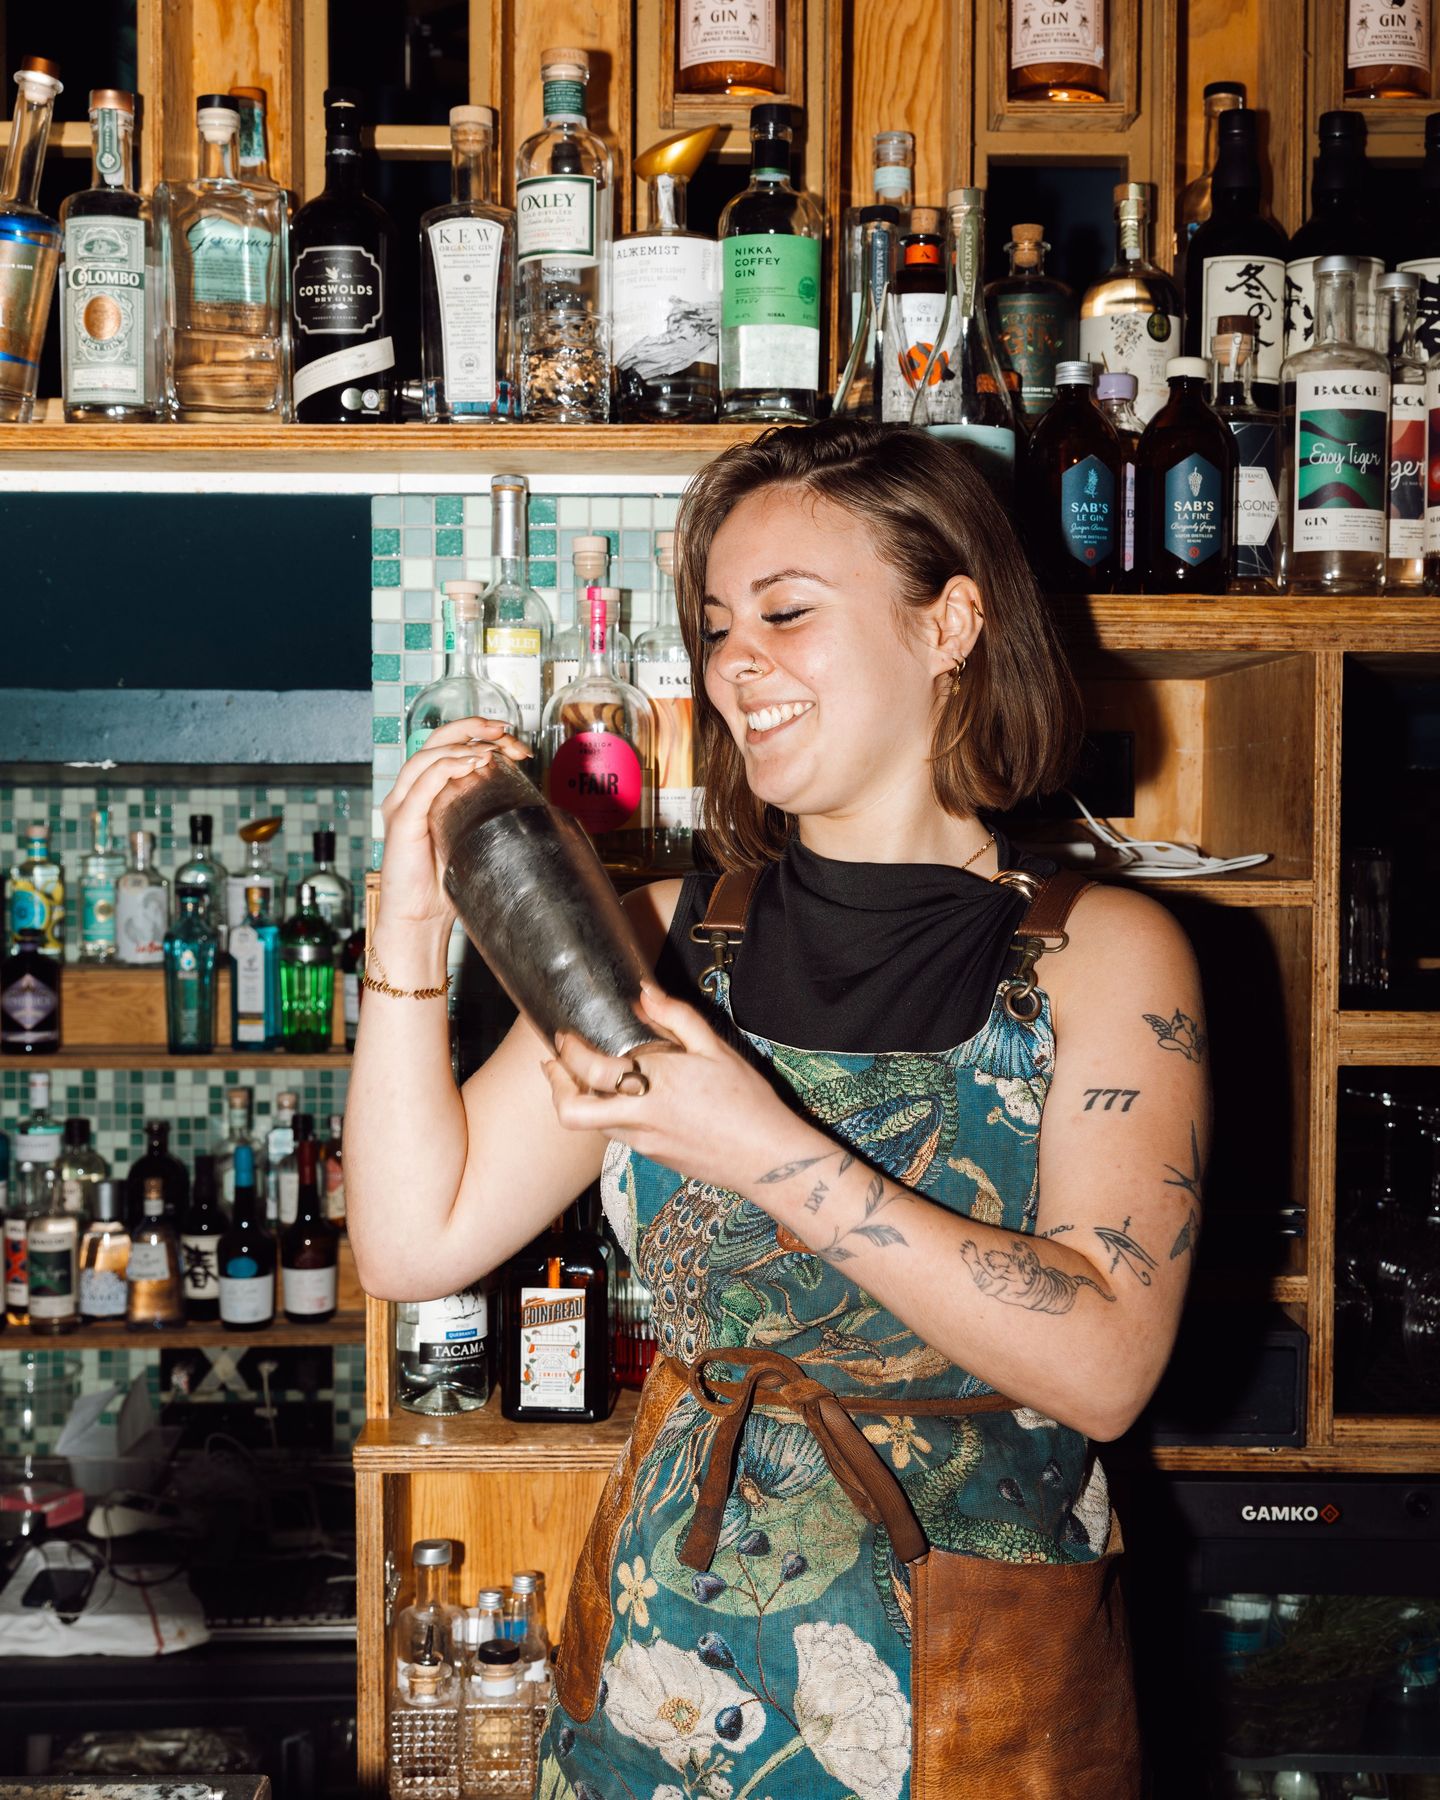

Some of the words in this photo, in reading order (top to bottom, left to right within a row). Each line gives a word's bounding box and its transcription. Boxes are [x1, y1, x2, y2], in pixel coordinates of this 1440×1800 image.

[710, 9, 738, 23] GIN
[1041, 12, 1069, 25] GIN
[1380, 14, 1407, 27] GIN
[521, 193, 576, 212] OXLEY
[440, 228, 493, 244] KEW
[735, 246, 773, 256] NIKKA
[735, 257, 781, 267] COFFEY
[68, 265, 140, 290] COLOMBO
[735, 268, 755, 278] GIN
[299, 284, 373, 297] COTSWOLDS
[1314, 384, 1382, 397] BACCAE
[1392, 396, 1425, 407] CCA
[1309, 442, 1346, 474] Easy
[1347, 442, 1381, 474] Tiger
[1391, 459, 1426, 491] ger
[1071, 501, 1109, 514] SAB'S
[1173, 500, 1215, 512] SAB'S
[1076, 514, 1087, 522] LE
[1090, 514, 1104, 522] GIN
[1177, 512, 1189, 520] LA
[1192, 512, 1211, 520] FINE
[1304, 516, 1329, 526] GIN
[1170, 522, 1199, 534] Burgundy
[487, 634, 538, 649] MERLET
[659, 675, 691, 686] BAC
[578, 772, 619, 796] FAIR
[1083, 1088, 1141, 1113] 777
[523, 1297, 583, 1327] COINTREAU
[448, 1330, 476, 1339] QUEBRANTA
[432, 1341, 485, 1357] TACAMA
[1242, 1505, 1319, 1522] GAMKO
